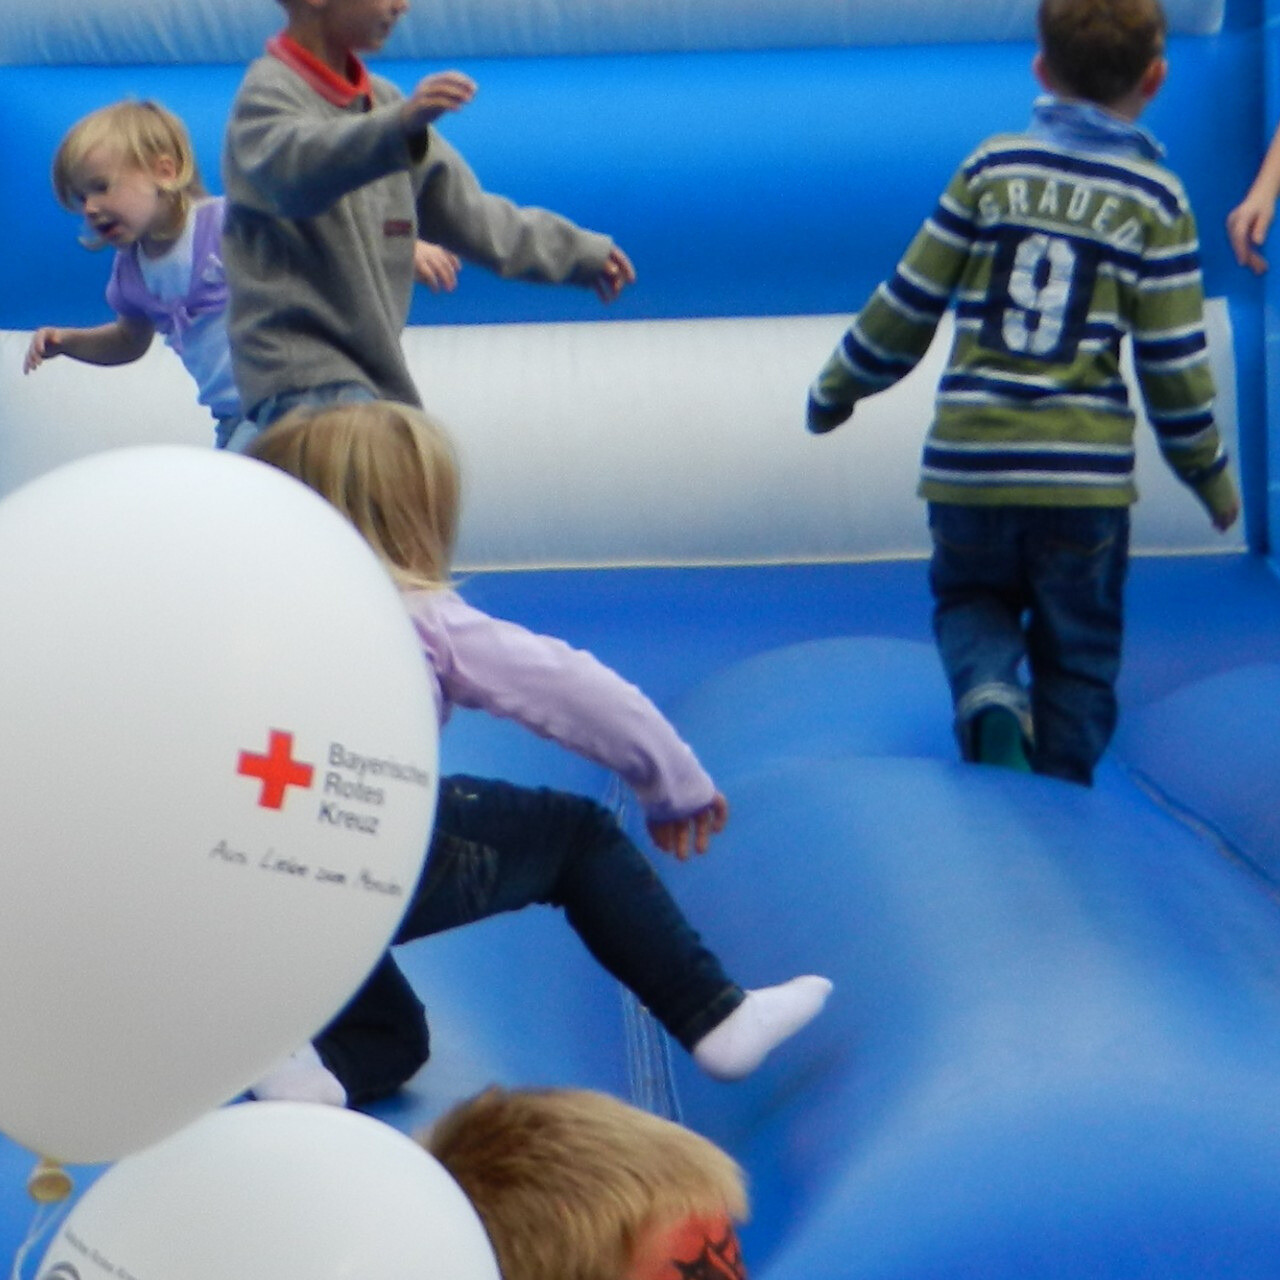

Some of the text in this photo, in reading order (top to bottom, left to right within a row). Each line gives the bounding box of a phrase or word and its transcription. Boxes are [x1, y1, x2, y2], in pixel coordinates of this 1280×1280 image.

[1001, 233, 1077, 357] 9
[324, 771, 384, 806] Rotes
[319, 801, 379, 836] Kreuz
